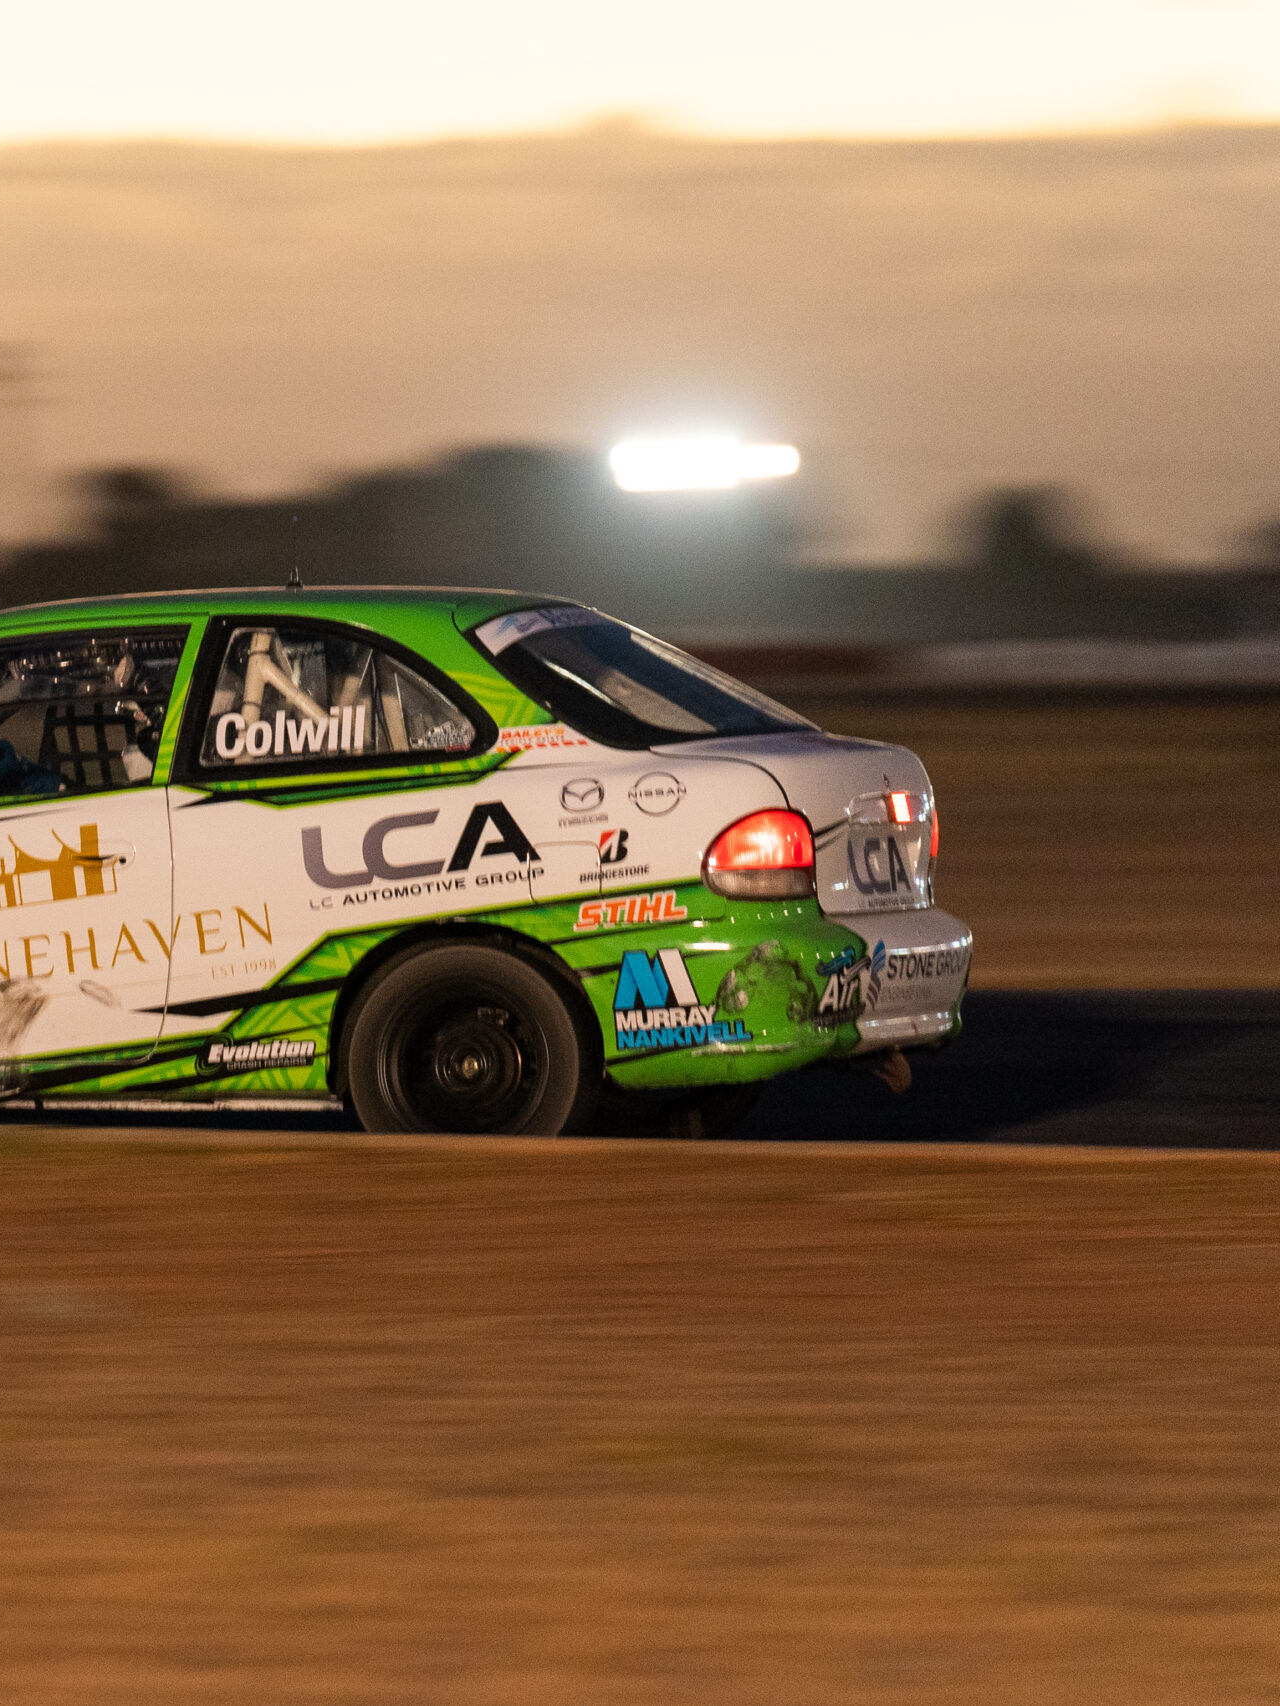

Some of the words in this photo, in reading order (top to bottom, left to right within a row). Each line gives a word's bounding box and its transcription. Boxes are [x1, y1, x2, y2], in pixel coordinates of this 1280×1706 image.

[215, 704, 366, 759] Colwill
[627, 785, 687, 801] NISSAN
[301, 799, 541, 889] LCA
[309, 896, 334, 911] LC
[342, 876, 467, 907] AUTOMOTIVE
[475, 866, 545, 887] GROUP
[579, 864, 650, 885] BRIDGESTONE
[573, 890, 688, 931] STIHL
[887, 954, 934, 980] STONE
[615, 1004, 716, 1033] MURRAY
[617, 1020, 753, 1050] NANKIVELL
[208, 1040, 315, 1063] Evolution
